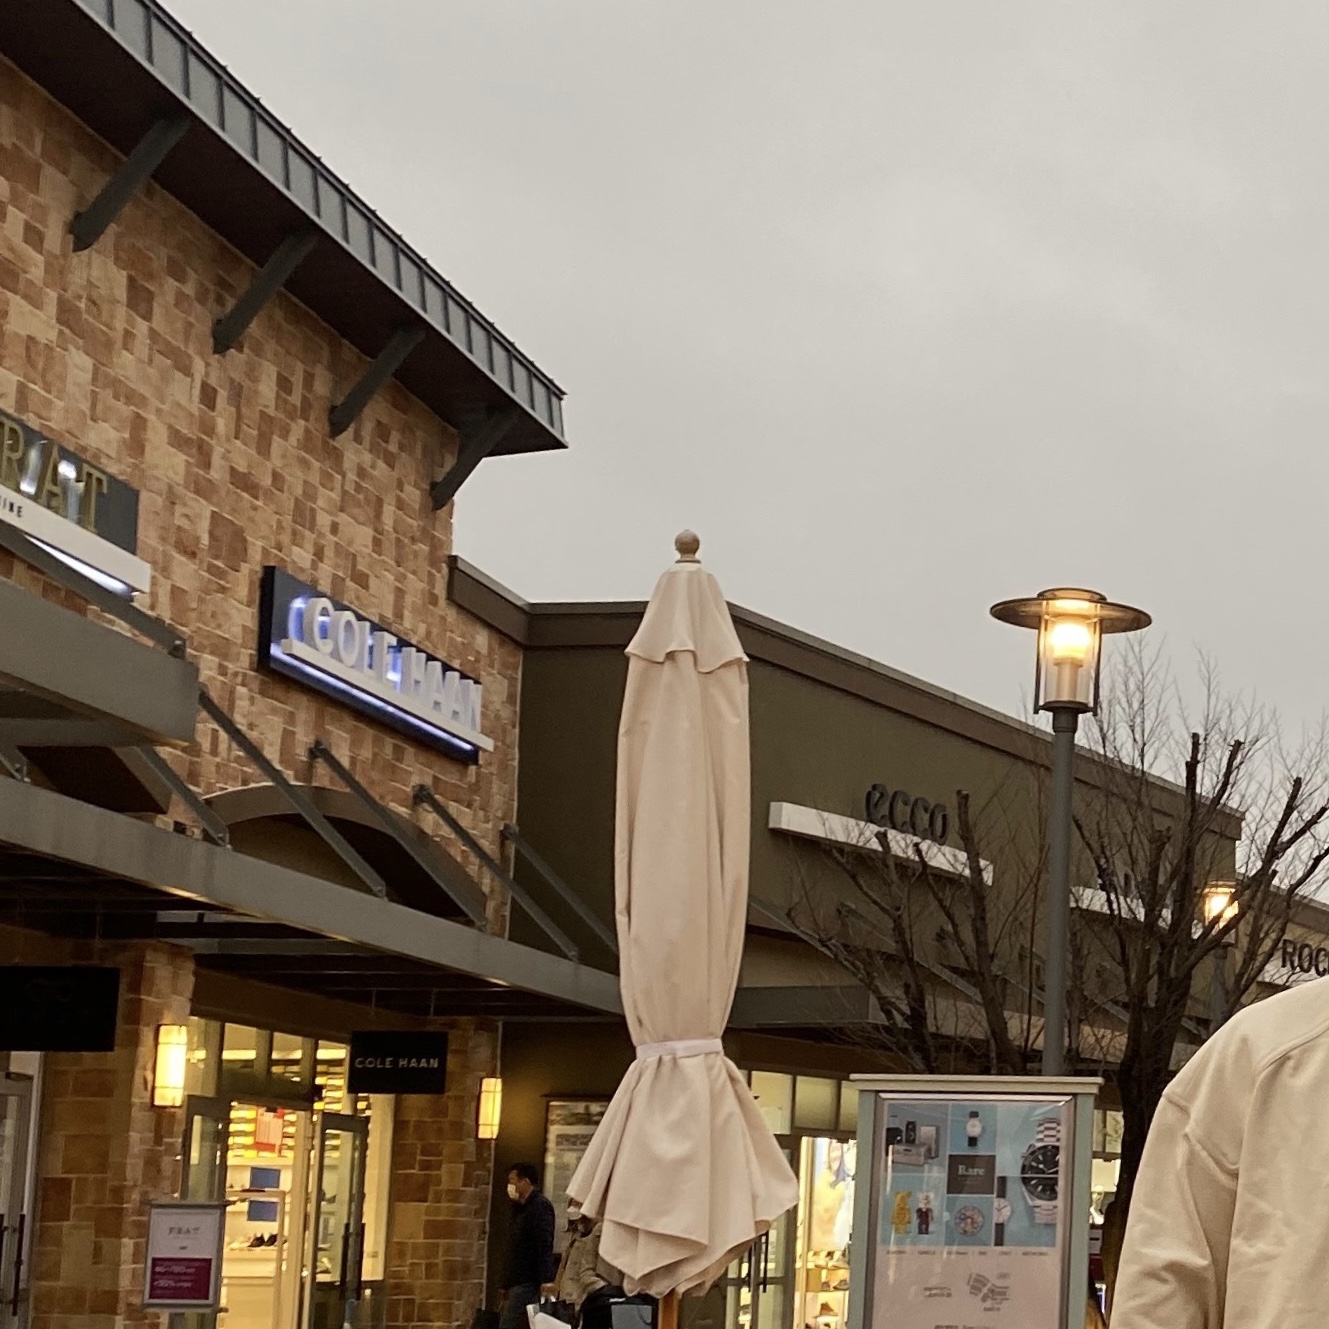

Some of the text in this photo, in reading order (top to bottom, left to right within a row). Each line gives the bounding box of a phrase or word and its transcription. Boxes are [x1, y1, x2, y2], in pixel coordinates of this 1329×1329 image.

[302, 597, 483, 733] COLE HAAN
[865, 784, 948, 846] ecco
[354, 1057, 439, 1068] COLE HAAN
